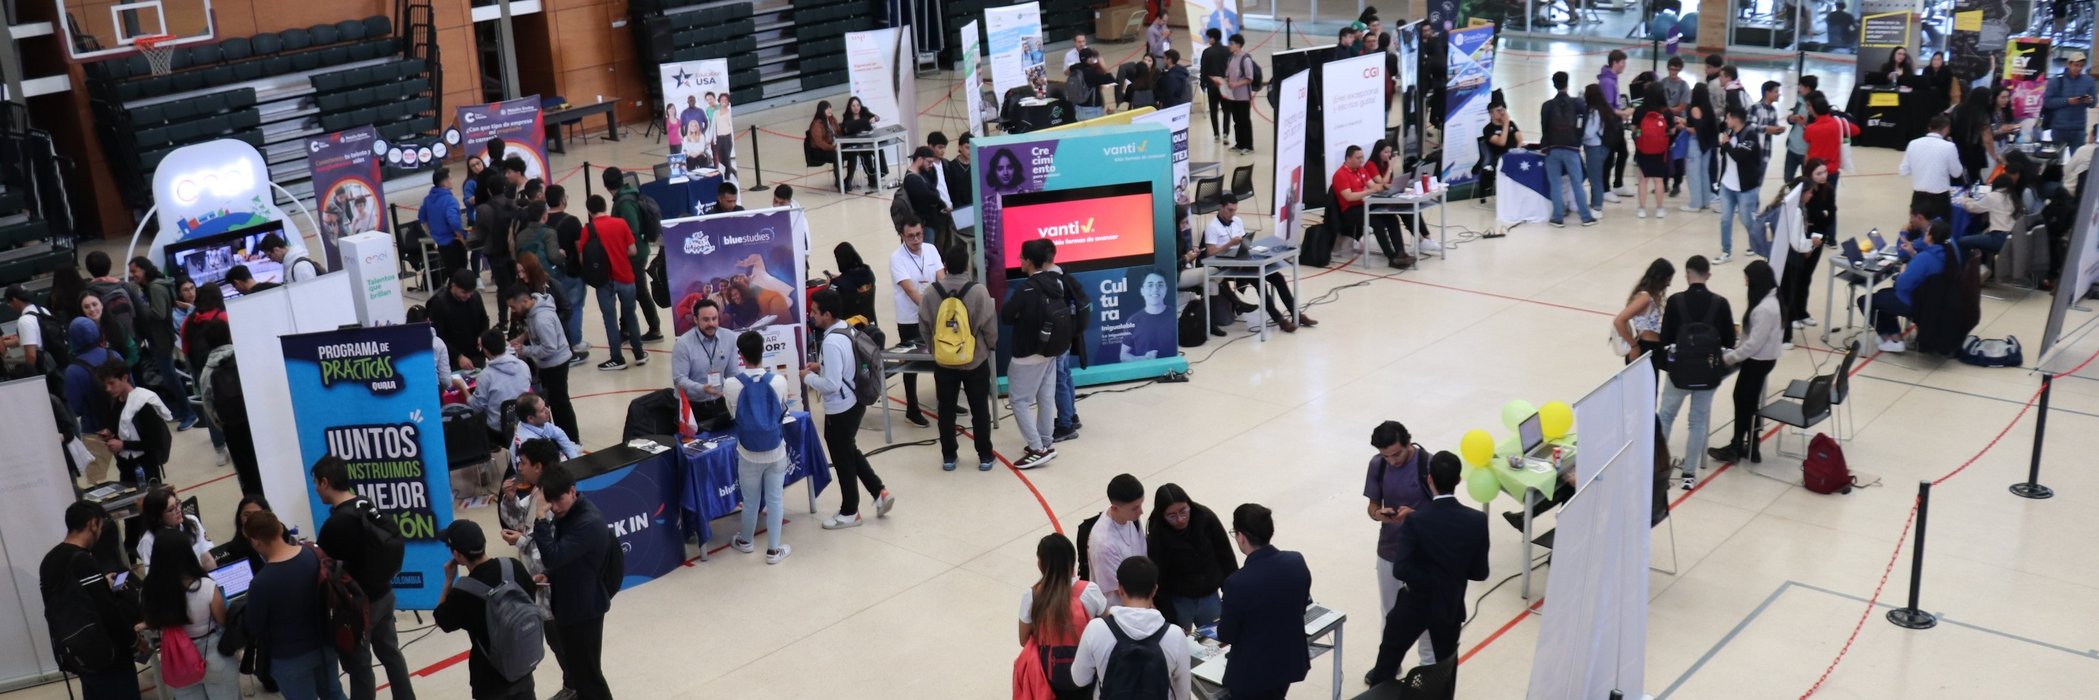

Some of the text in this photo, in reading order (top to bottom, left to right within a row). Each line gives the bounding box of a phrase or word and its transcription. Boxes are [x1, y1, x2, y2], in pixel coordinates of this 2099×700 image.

[2012, 56, 2031, 68] EY
[1363, 66, 1379, 78] CGI
[696, 77, 716, 86] USA
[2025, 94, 2041, 106] EY
[491, 122, 502, 130] tipo
[511, 119, 533, 127] empresa
[1867, 119, 1880, 127] EY
[1031, 147, 1050, 156] Cre
[1104, 143, 1136, 156] vanti
[1032, 155, 1054, 166] cimi
[1033, 165, 1056, 174] ento
[1038, 220, 1079, 238] vanti
[724, 232, 770, 245] bluestudies
[1095, 234, 1119, 242] avanzar
[1100, 277, 1127, 294] Cul
[370, 290, 392, 300] brillan
[1100, 294, 1119, 308] tu
[1101, 309, 1120, 321] ra
[1101, 322, 1135, 332] Inigualable
[318, 341, 390, 360] PROGRAMA DE
[320, 355, 394, 385] PRÁCTICAS
[372, 380, 397, 391] QUALA
[327, 425, 417, 461] JUNTOS
[346, 460, 421, 480] NSTRUIMOS
[356, 481, 427, 510] MEJOR
[629, 512, 649, 533] IN
